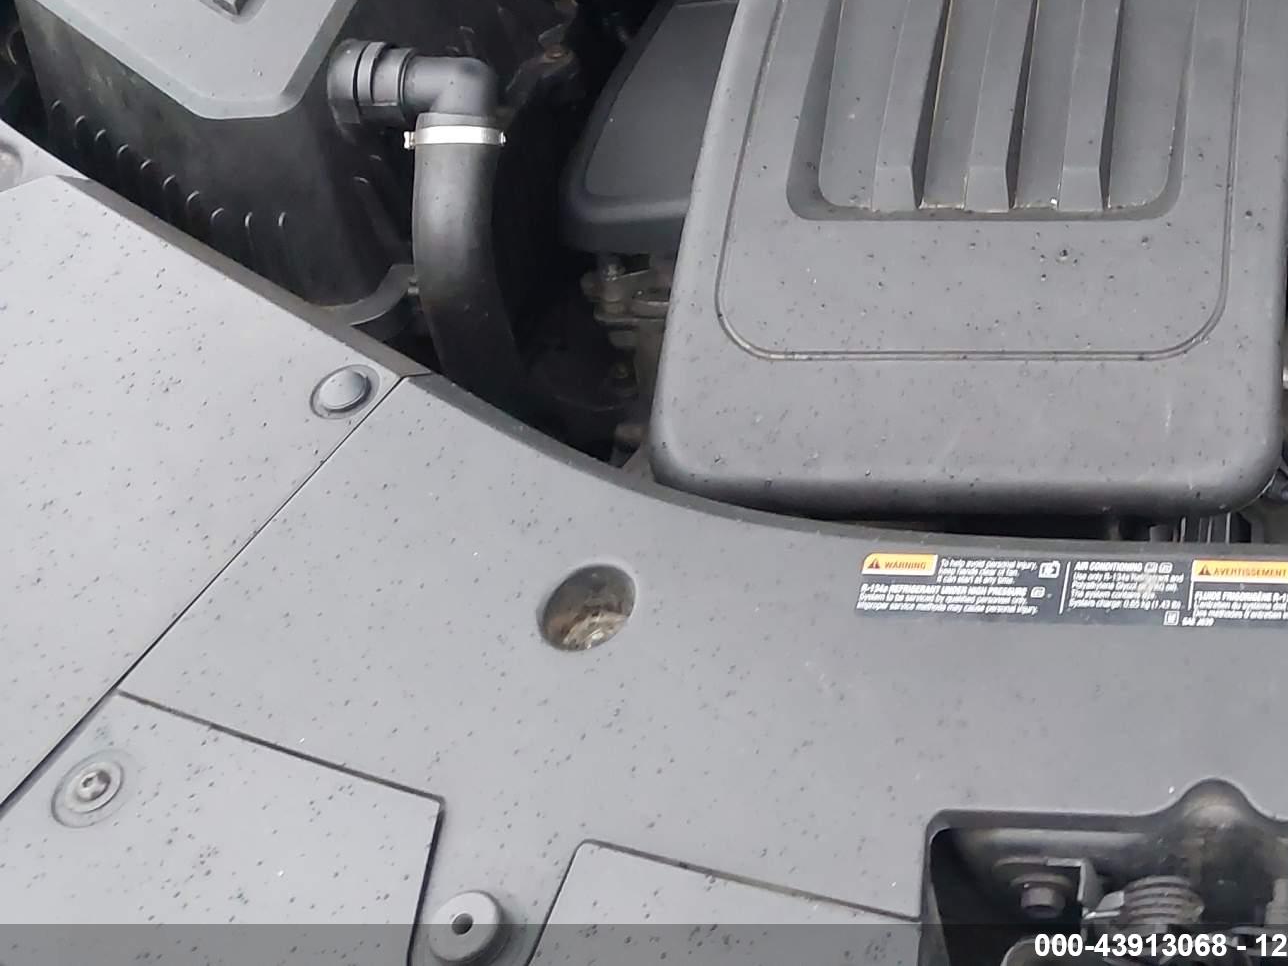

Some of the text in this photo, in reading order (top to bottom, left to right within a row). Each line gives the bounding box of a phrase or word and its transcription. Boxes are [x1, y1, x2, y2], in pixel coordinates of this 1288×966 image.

[884, 561, 927, 570] WARNING
[1074, 561, 1143, 572] AIR CONDITIONING
[1214, 568, 1288, 577] AVERTISSEMENT
